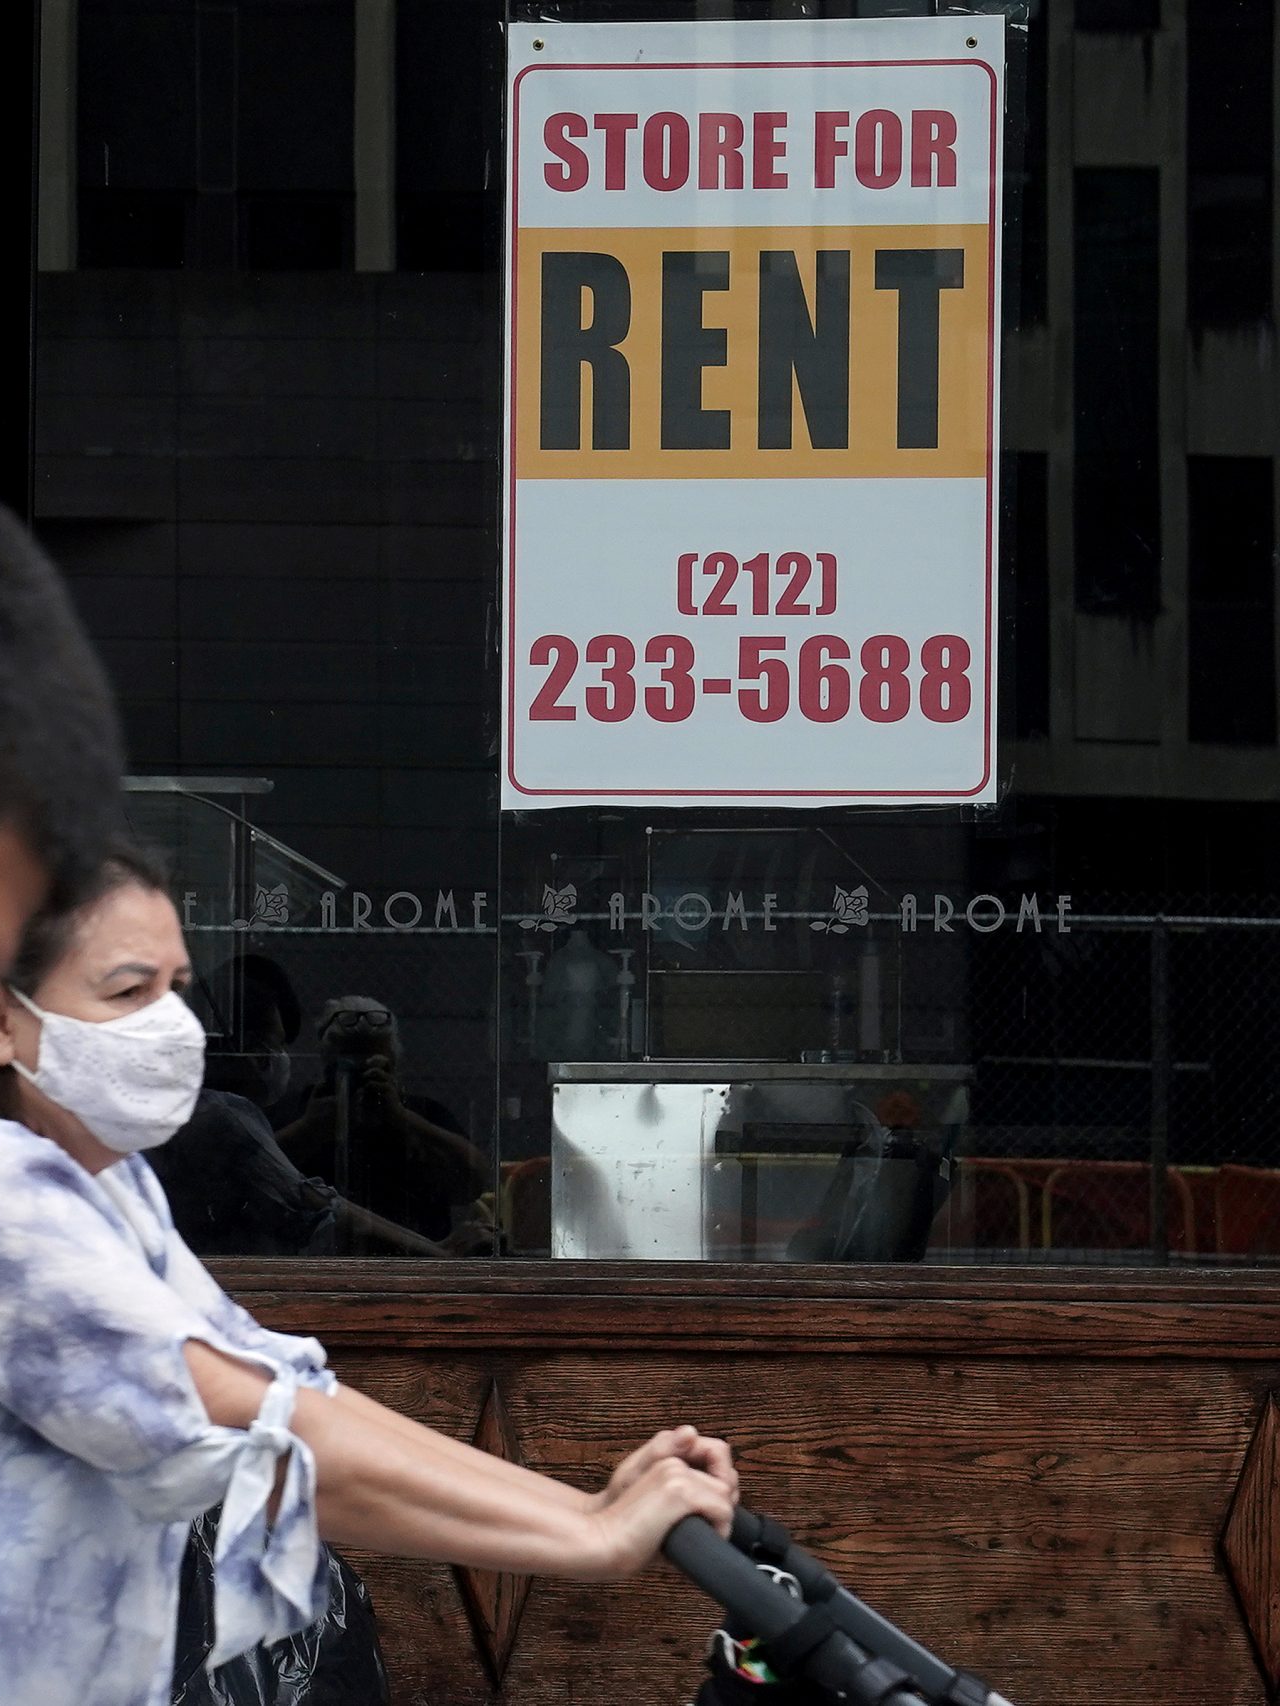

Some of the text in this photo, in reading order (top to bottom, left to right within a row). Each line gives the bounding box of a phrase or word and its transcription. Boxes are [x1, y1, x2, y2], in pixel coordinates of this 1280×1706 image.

[542, 108, 959, 194] STORE FOR
[538, 247, 966, 452] RENT
[676, 551, 839, 618] (212)
[527, 634, 974, 725] 233-5688
[319, 889, 488, 930] AROME
[608, 889, 778, 933] AROME
[899, 890, 1073, 935] AROME
